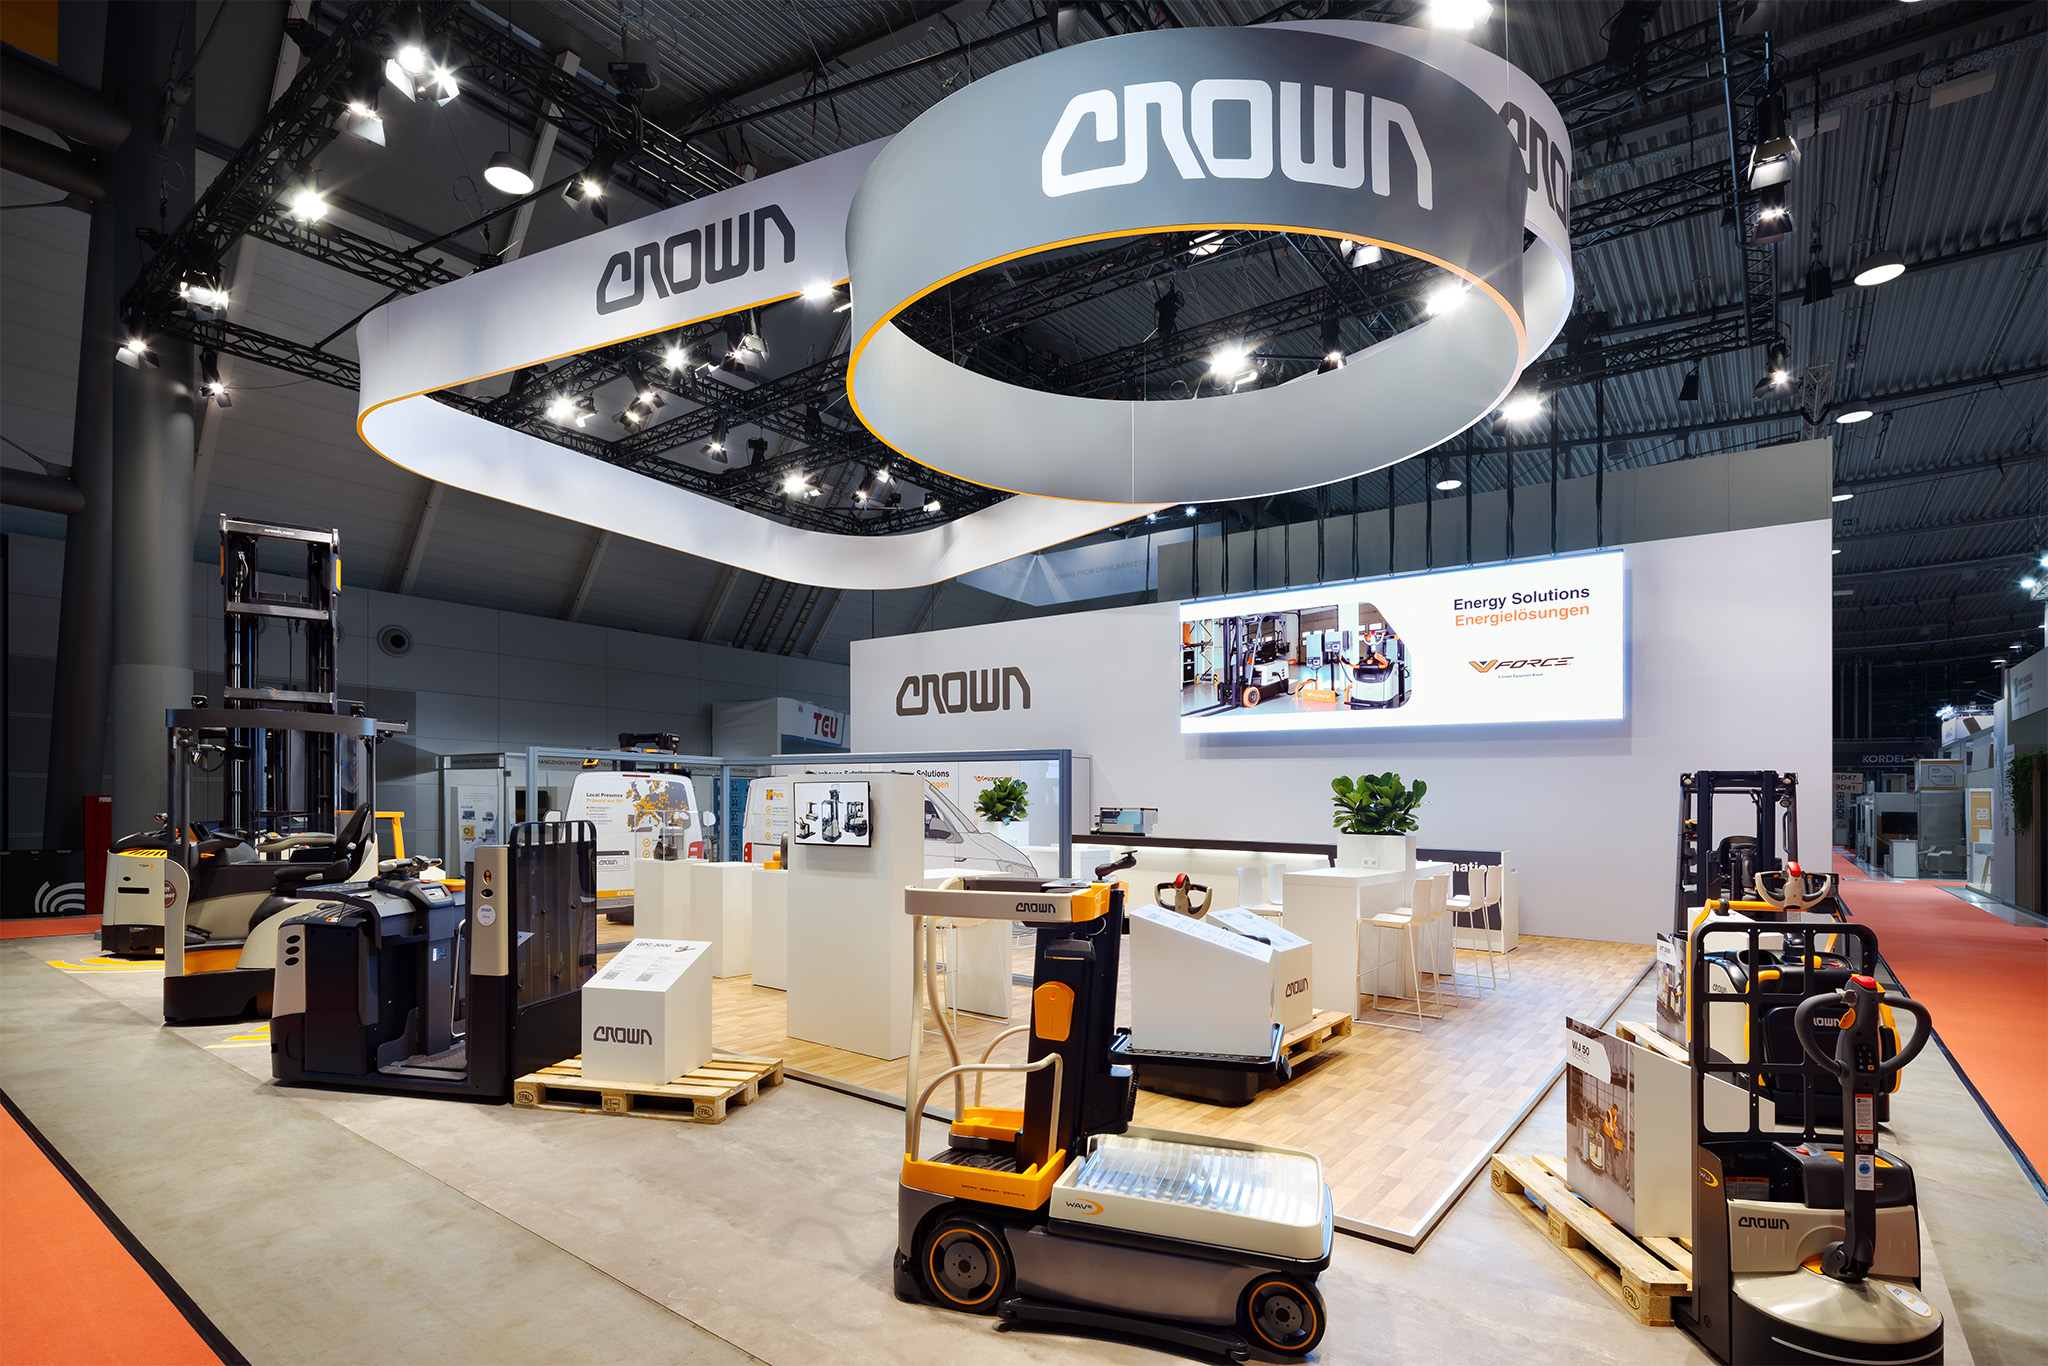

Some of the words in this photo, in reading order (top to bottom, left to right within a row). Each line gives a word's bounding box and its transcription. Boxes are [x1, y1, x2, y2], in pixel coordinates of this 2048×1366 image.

[1042, 79, 1433, 211] CROWN
[596, 204, 796, 316] CROWN
[1077, 568, 1095, 577] FROM
[1454, 597, 1507, 610] Energy
[1512, 588, 1590, 605] Solutions
[1455, 605, 1590, 627] Energielösungen
[896, 666, 1031, 717] CROWN
[813, 712, 839, 739] TEU
[1015, 902, 1056, 914] CROWN
[1285, 977, 1309, 998] CROWN
[593, 1025, 652, 1046] CROWN
[1582, 1045, 1590, 1056] 50
[518, 1093, 533, 1102] EPAL
[697, 1107, 714, 1116] EPAL
[1065, 1201, 1093, 1210] WAVE
[1738, 1216, 1790, 1230] CROWN
[1624, 1287, 1638, 1308] EPAL
